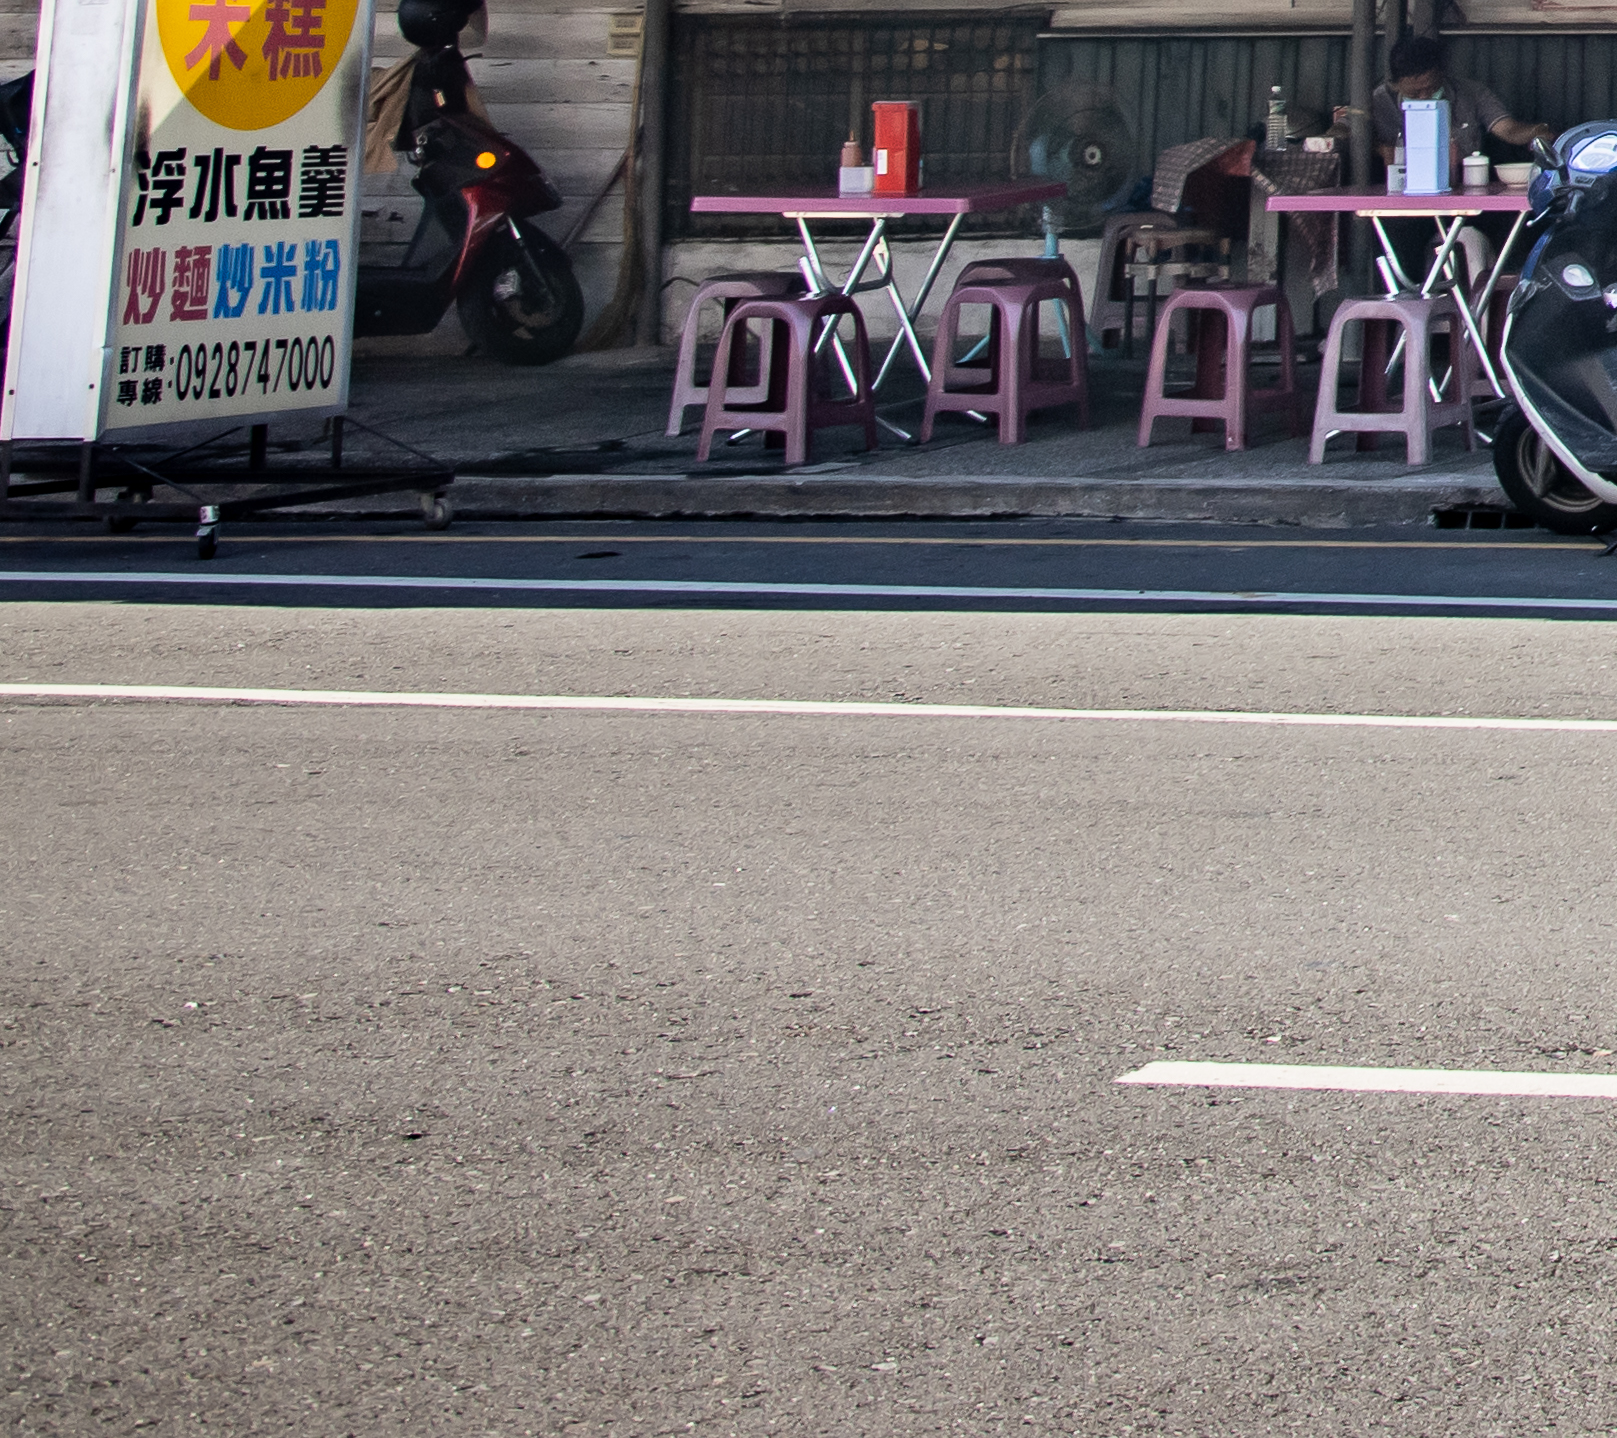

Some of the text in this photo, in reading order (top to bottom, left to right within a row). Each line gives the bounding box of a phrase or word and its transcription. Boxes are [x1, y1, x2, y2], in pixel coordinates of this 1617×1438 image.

[132, 145, 348, 226] 浮水魚羹
[123, 239, 340, 325] 炒麵 炒米粉
